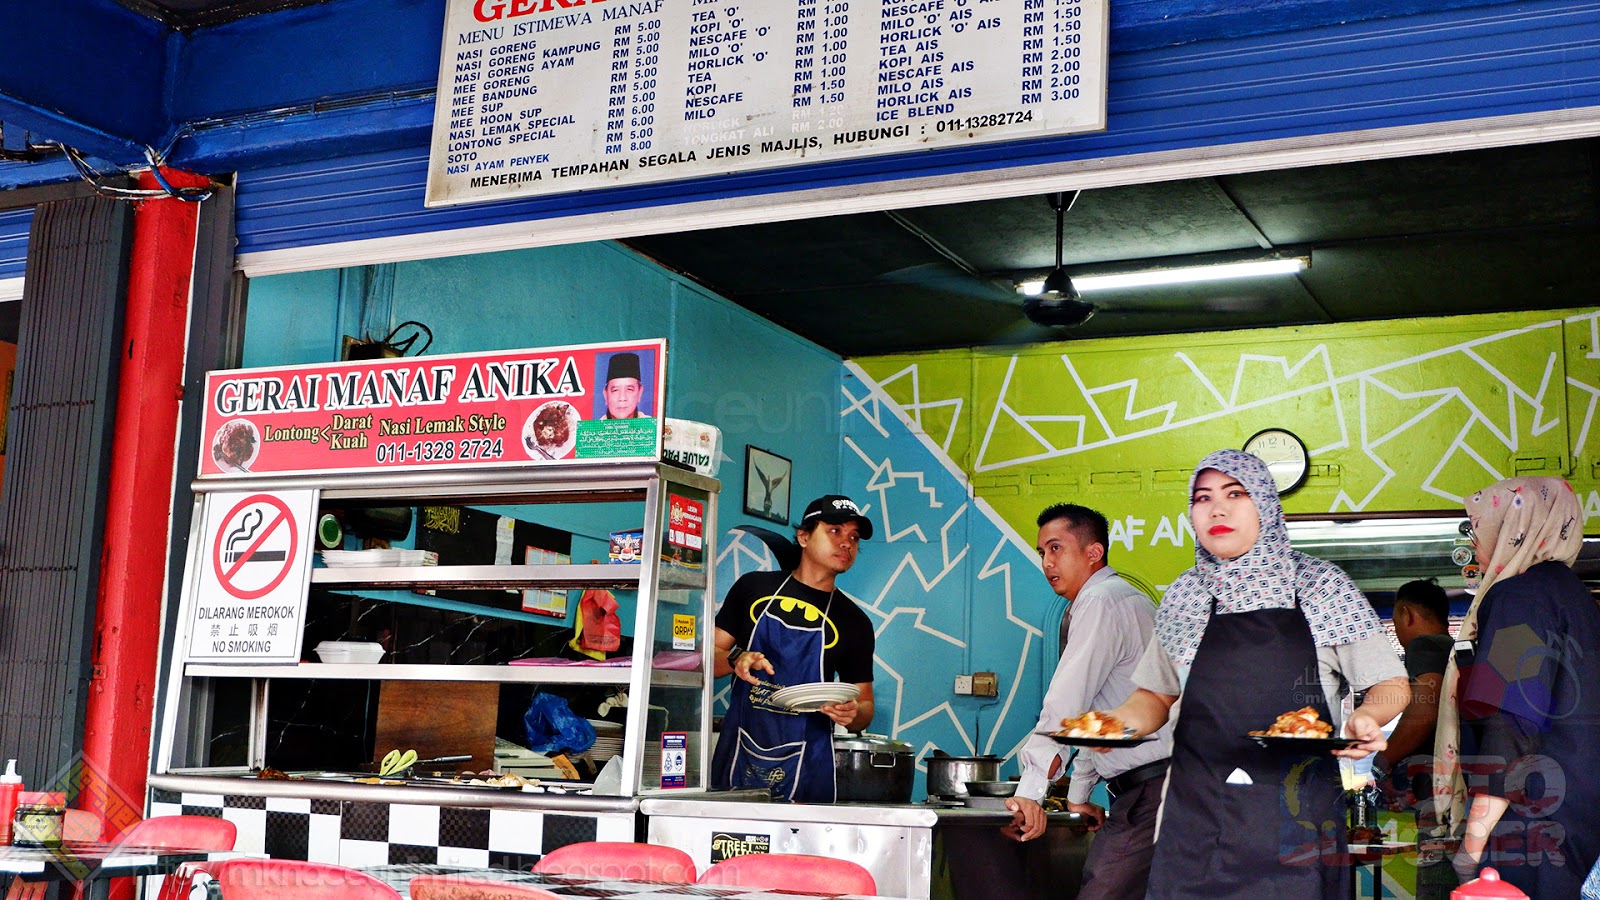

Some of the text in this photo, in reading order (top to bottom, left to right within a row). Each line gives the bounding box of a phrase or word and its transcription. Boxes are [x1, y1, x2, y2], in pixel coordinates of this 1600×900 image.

[798, 8, 816, 18] RM
[824, 3, 849, 14] 1.00
[881, 1, 944, 18] NESCAFE
[1024, 0, 1044, 10] RM
[458, 27, 504, 46] MENU
[513, 12, 592, 37] ISTIMEWA
[602, 0, 664, 22] MANAF
[692, 11, 716, 22] TEA
[797, 15, 848, 31] RM 1.00
[881, 17, 914, 31] MILO
[949, 9, 973, 21] AIS
[1024, 7, 1081, 23] RM 1.50
[614, 20, 661, 35] RM 5.00
[690, 22, 720, 35] KOPI
[880, 26, 942, 44] HORLICK
[977, 18, 1001, 30] AIS
[1023, 20, 1081, 37] RM 1.50
[613, 32, 660, 47] RM 5.00
[690, 30, 747, 47] NESCAFE
[796, 28, 848, 44] RM 1.00
[1023, 34, 1081, 50] RM 1.50
[457, 40, 537, 61] NASI GORENG
[612, 44, 659, 59] RM 5.00
[688, 47, 719, 59] MILO
[795, 40, 847, 56] RM 1.00
[880, 40, 939, 57] TEA AIS
[1022, 47, 1081, 64] RM 2.00
[456, 41, 601, 72] NASI GORENG KAMPUNG
[611, 56, 658, 71] RM 5.00
[688, 55, 744, 71] HORLICK
[795, 53, 846, 69] RM 1.00
[879, 52, 944, 69] KOPI AIS
[454, 57, 574, 84] NASI GORENG AYAM
[610, 68, 657, 83] RM 5.00
[794, 66, 846, 81] RM 1.00
[878, 61, 974, 82] NESCAFE AIS
[1022, 61, 1080, 77] RM 2.00
[453, 76, 530, 95] MEE GORENG
[687, 72, 712, 84] TEA
[1022, 74, 1080, 91] RM 2.00
[610, 80, 656, 95] RM 5.00
[686, 84, 716, 96] KOPI
[793, 79, 845, 95] RM 1.50
[878, 78, 944, 95] MILO AIS
[452, 86, 538, 107] MEE BANDUNG
[609, 92, 655, 107] RM 5.00
[685, 92, 743, 108] NESCAFE
[793, 92, 844, 107] RM 1.50
[877, 88, 972, 108] HORLICK AIS
[1021, 88, 1079, 104] RM 3.00
[451, 102, 504, 118] MEE SUP
[608, 104, 654, 118] RM 6.00
[684, 108, 716, 120] MILO
[876, 103, 954, 121] ICE BLEND
[450, 108, 542, 130] MEE HOON SUP
[607, 116, 654, 131] RM 6.00
[449, 115, 576, 141] NASI LEMAK SPECIAL
[606, 128, 653, 142] RM 5.00
[448, 129, 556, 152] LONTONG SPECIAL
[605, 141, 652, 154] RM 8.00
[470, 170, 542, 188] MENERIMA
[551, 159, 629, 178] TEMPAHAN
[638, 150, 697, 169] SEGALA
[706, 144, 751, 160] JENIS
[761, 136, 823, 153] MAJLIS,
[833, 124, 910, 146] HUBUNGI
[936, 110, 1033, 132] 011-13282724
[446, 154, 550, 175] NASI AYAM PENYEK
[448, 152, 477, 164] SOTO
[216, 359, 583, 414] GERAI MANAF ANIKA
[333, 414, 372, 430] Darat
[379, 414, 506, 436] Nasi Lemak Style
[264, 425, 319, 444] Lontong
[330, 433, 368, 450] Kuah
[377, 438, 502, 462] 011-1328 2724
[198, 606, 294, 620] DILARANG MEROKOK
[212, 640, 271, 653] NO SMOKING
